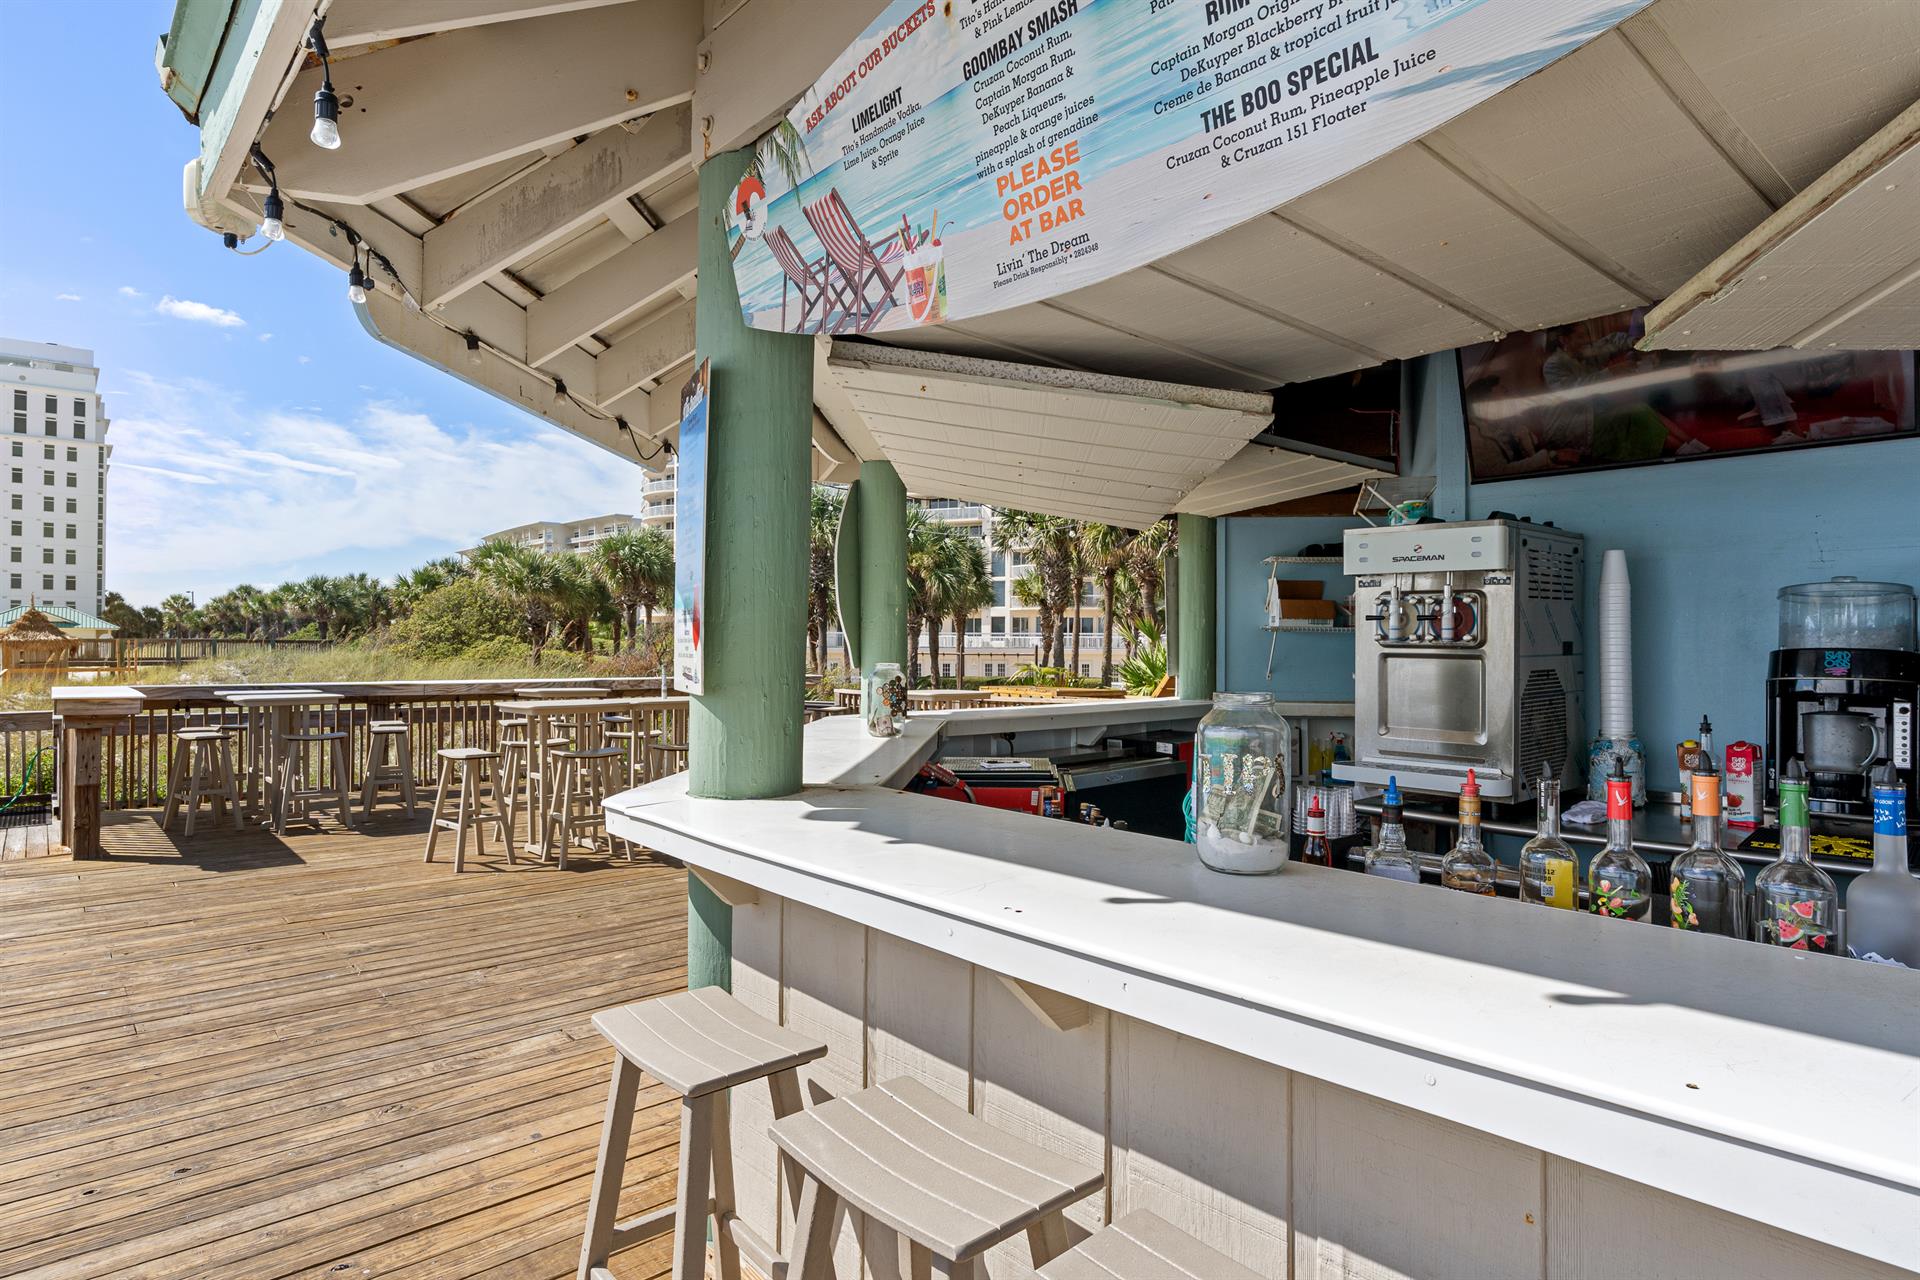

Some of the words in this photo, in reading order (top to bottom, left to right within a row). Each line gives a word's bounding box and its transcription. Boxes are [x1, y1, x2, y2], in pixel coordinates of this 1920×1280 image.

[959, 9, 983, 30] Tito's
[962, 27, 1023, 81] GOOMBAY
[1027, 0, 1078, 41] SMASH
[974, 27, 982, 39] &
[983, 12, 1003, 34] Pink
[1004, 0, 1034, 19] Lemo
[1150, 45, 1200, 75] Captain
[1202, 17, 1254, 49] Morgan
[1180, 44, 1243, 82] DeKuyper
[1246, 3, 1323, 50] Blackberry
[806, 104, 824, 134] ASK
[824, 70, 857, 115] ABOUT
[858, 47, 882, 79] OUR
[881, 0, 937, 57] BUCKETS
[973, 70, 1005, 93] Cruzan
[1006, 45, 1045, 74] Coconut
[1047, 30, 1072, 50] Rum,
[975, 84, 1011, 110] Captain
[1012, 64, 1048, 89] Morgan
[1050, 48, 1076, 68] Rum,
[1153, 90, 1193, 115] Creme
[1197, 81, 1212, 96] de
[1214, 54, 1266, 87] Banana
[1270, 46, 1281, 61] &
[1284, 15, 1342, 54] tropical
[1345, 0, 1380, 25] fruit
[1200, 99, 1237, 134] THE
[1241, 79, 1282, 117] BOO
[1286, 37, 1379, 96] SPECIAL
[851, 86, 902, 134] LIMELIGHT
[981, 95, 1025, 125] DeKuyper
[1027, 73, 1064, 100] Banana
[1065, 65, 1074, 78] &
[993, 113, 1020, 136] Peach
[1021, 92, 1066, 121] Liqueurs,
[1166, 145, 1210, 169] Cruzan
[1212, 119, 1267, 150] Coconut
[1270, 105, 1307, 127] Rum,
[1310, 68, 1389, 110] Pineapple
[1393, 49, 1437, 77] Juice
[841, 140, 859, 156] Tito's
[859, 117, 897, 146] Handmade
[896, 101, 922, 120] Vodka,
[843, 156, 860, 171] Lime
[879, 128, 906, 149] Orange
[906, 116, 925, 135] Juice
[975, 134, 1019, 166] pineapple
[1020, 128, 1028, 140] &
[1029, 112, 1063, 135] orange
[1064, 95, 1095, 120] juices
[976, 165, 996, 180] with
[997, 160, 1003, 170] a
[1005, 142, 1035, 167] splash
[1036, 135, 1049, 150] of
[1047, 112, 1099, 147] grenadine
[1221, 155, 1231, 168] &
[1233, 136, 1283, 162] Cruzan
[1287, 122, 1308, 142] 151
[1312, 101, 1367, 131] Floater
[871, 160, 878, 170] &
[877, 149, 899, 166] Sprite
[996, 139, 1081, 198] PLEASE
[1003, 170, 1083, 221] ORDER
[1010, 217, 1033, 246] AT
[1039, 198, 1085, 232] BAR
[993, 278, 1012, 289] Please
[1013, 270, 1030, 282] Drink
[1030, 255, 1068, 276] Responsibly
[1028, 248, 1049, 264] The
[1051, 232, 1090, 255] Dream
[1392, 554, 1445, 563] SPACEMAN
